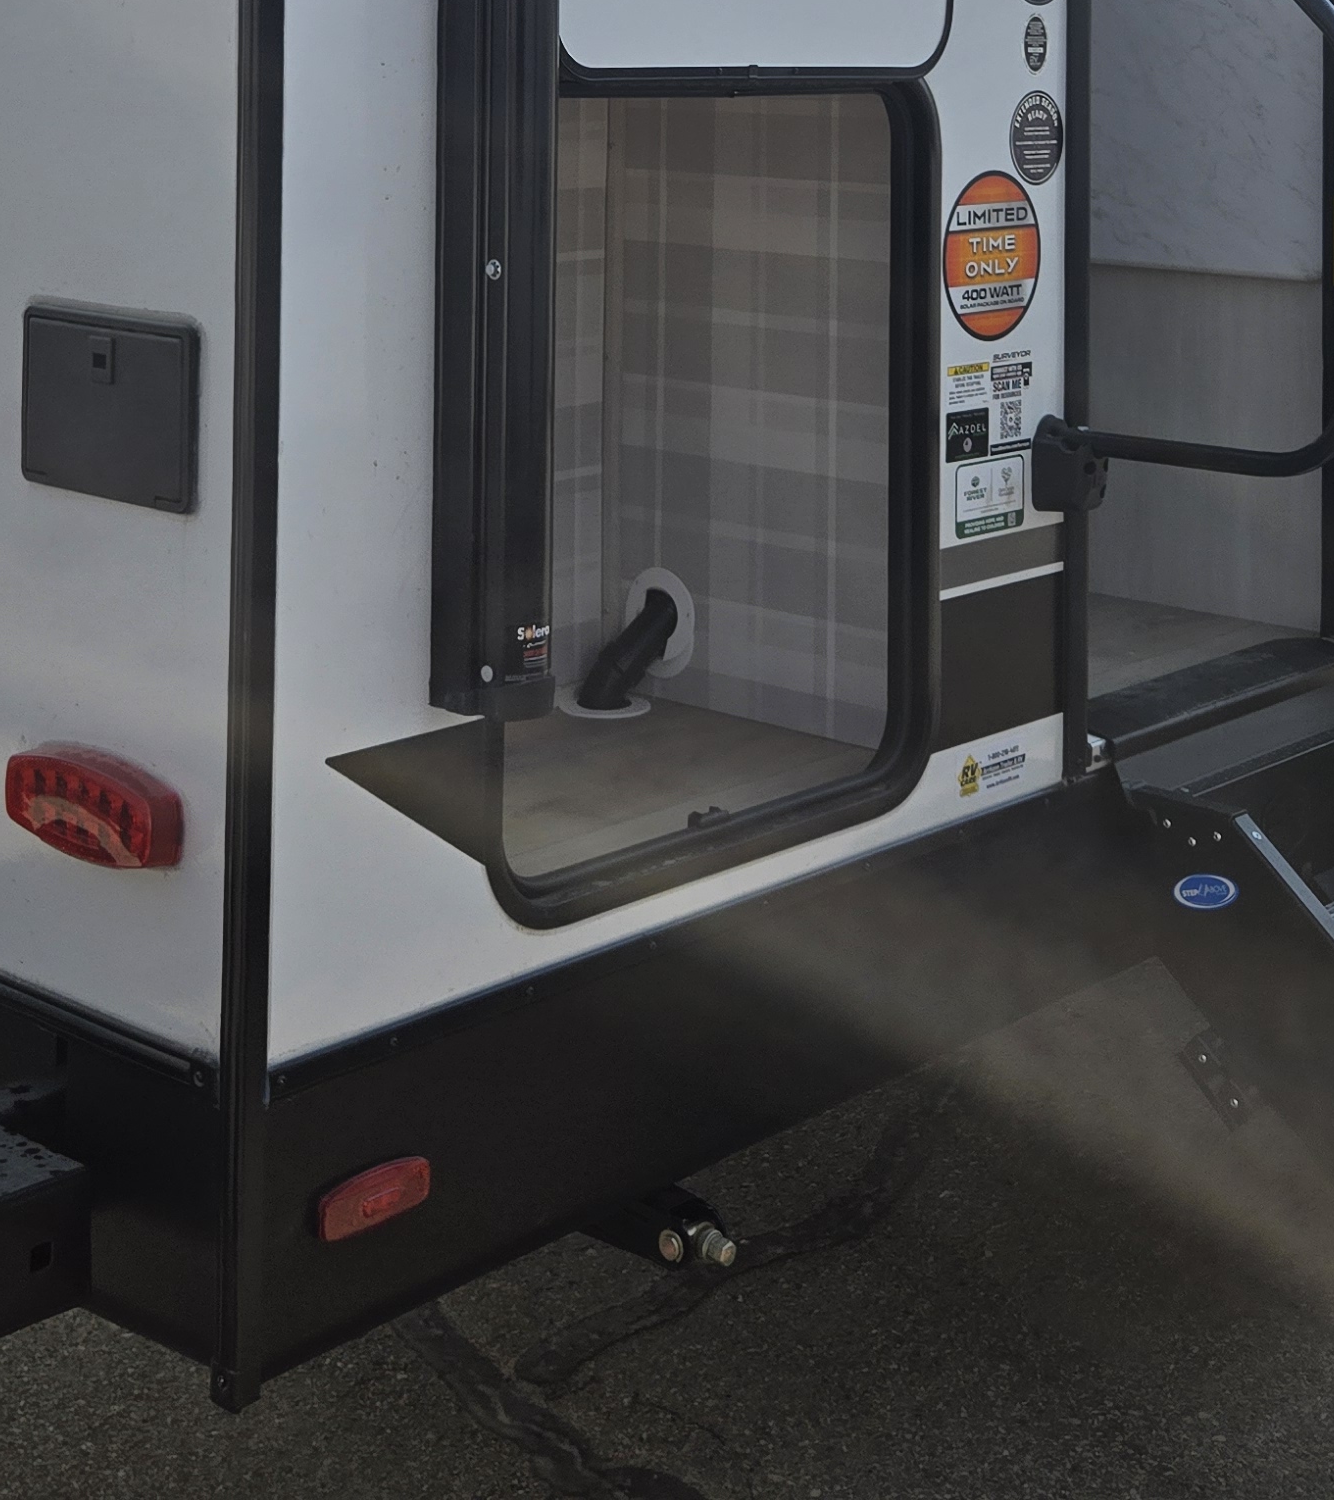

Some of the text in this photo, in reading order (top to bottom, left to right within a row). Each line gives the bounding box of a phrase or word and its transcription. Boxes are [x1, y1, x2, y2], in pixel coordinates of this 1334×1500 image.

[1014, 96, 1041, 128] EXTENDED
[1027, 109, 1047, 122] READY
[956, 206, 1028, 226] LIMITED
[969, 234, 1016, 253] TIME
[965, 257, 1018, 278] ONLY
[961, 284, 1022, 302] 400 WATT
[1007, 296, 1024, 304] BOARD
[992, 350, 1031, 360] SURVEYOR
[993, 378, 1022, 392] SCAN ME
[958, 423, 986, 435] AZDEL
[963, 487, 987, 497] FOREST
[966, 493, 985, 501] RIVER
[517, 624, 550, 641] Solero
[961, 762, 978, 779] RV
[960, 775, 977, 788] CARE
